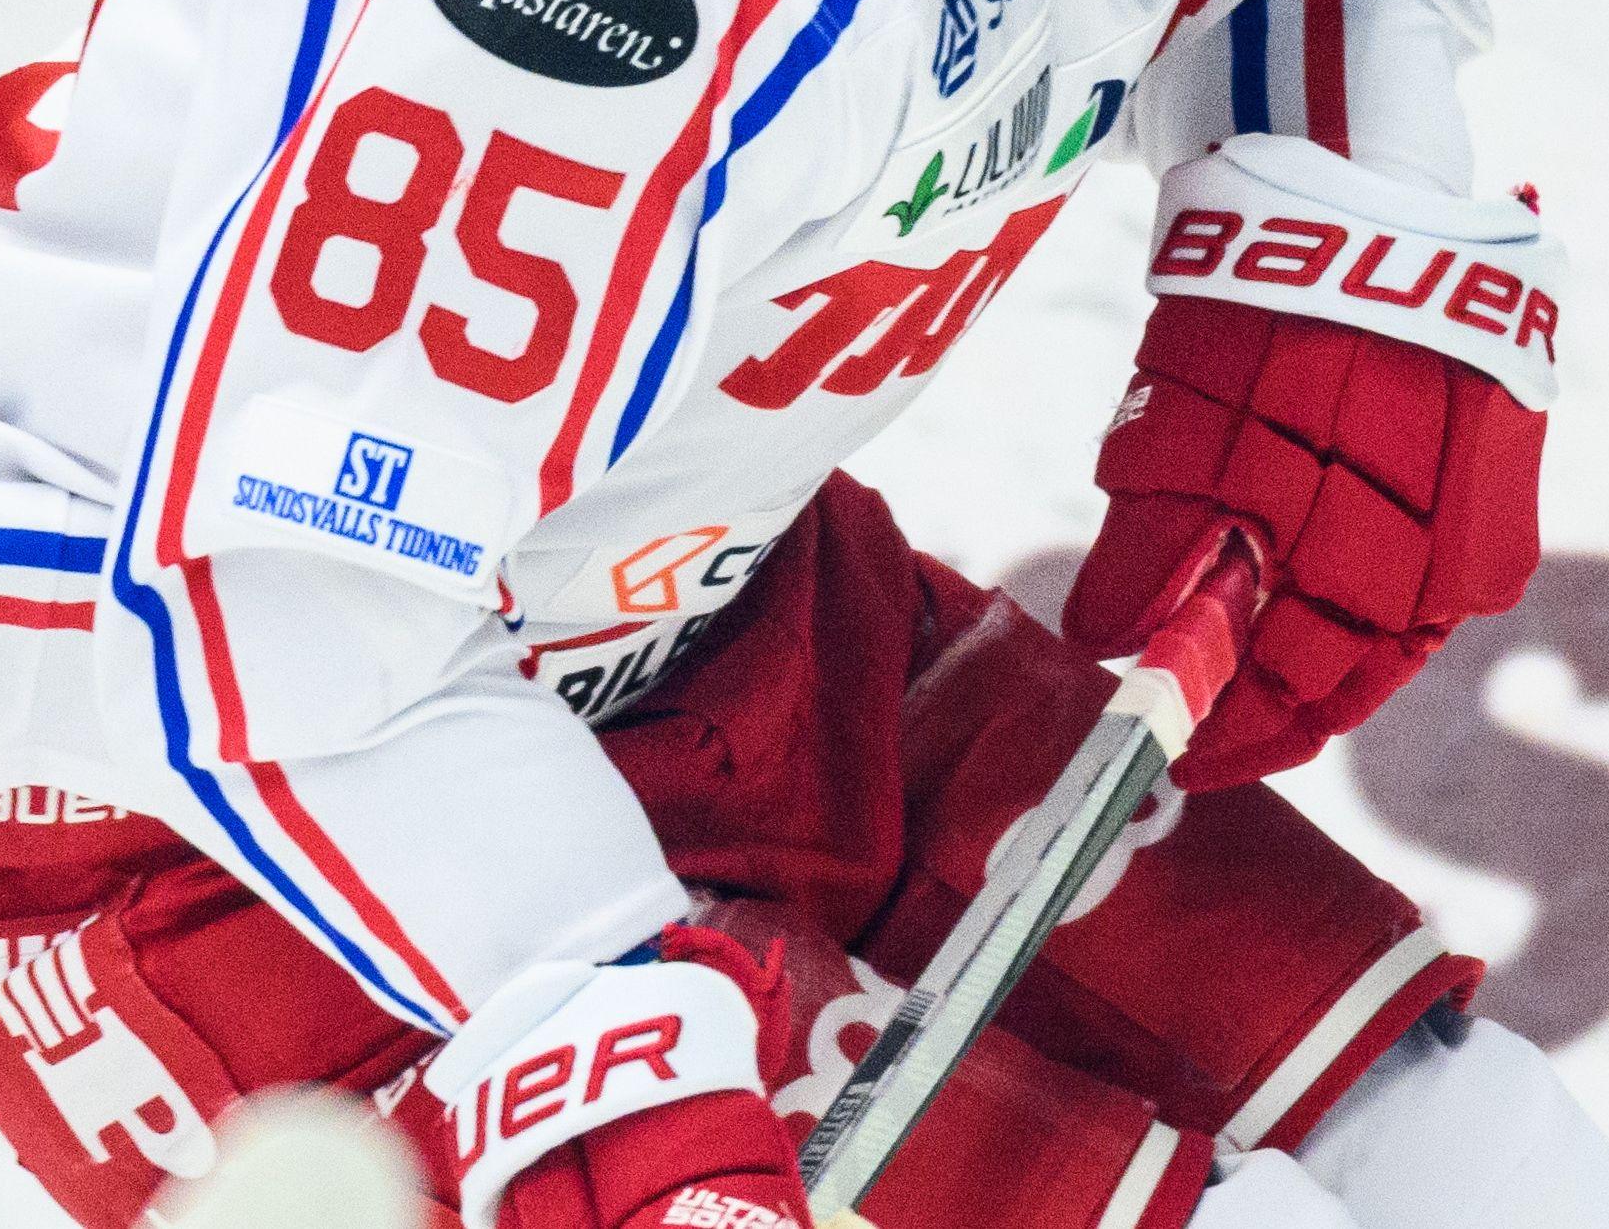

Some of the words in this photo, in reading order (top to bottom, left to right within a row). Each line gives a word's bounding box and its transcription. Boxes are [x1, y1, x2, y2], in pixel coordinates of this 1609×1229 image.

[269, 85, 626, 404] 85
[341, 437, 409, 505] ST
[232, 474, 383, 546] SUNDSVALLS
[385, 518, 485, 577] TIDNING
